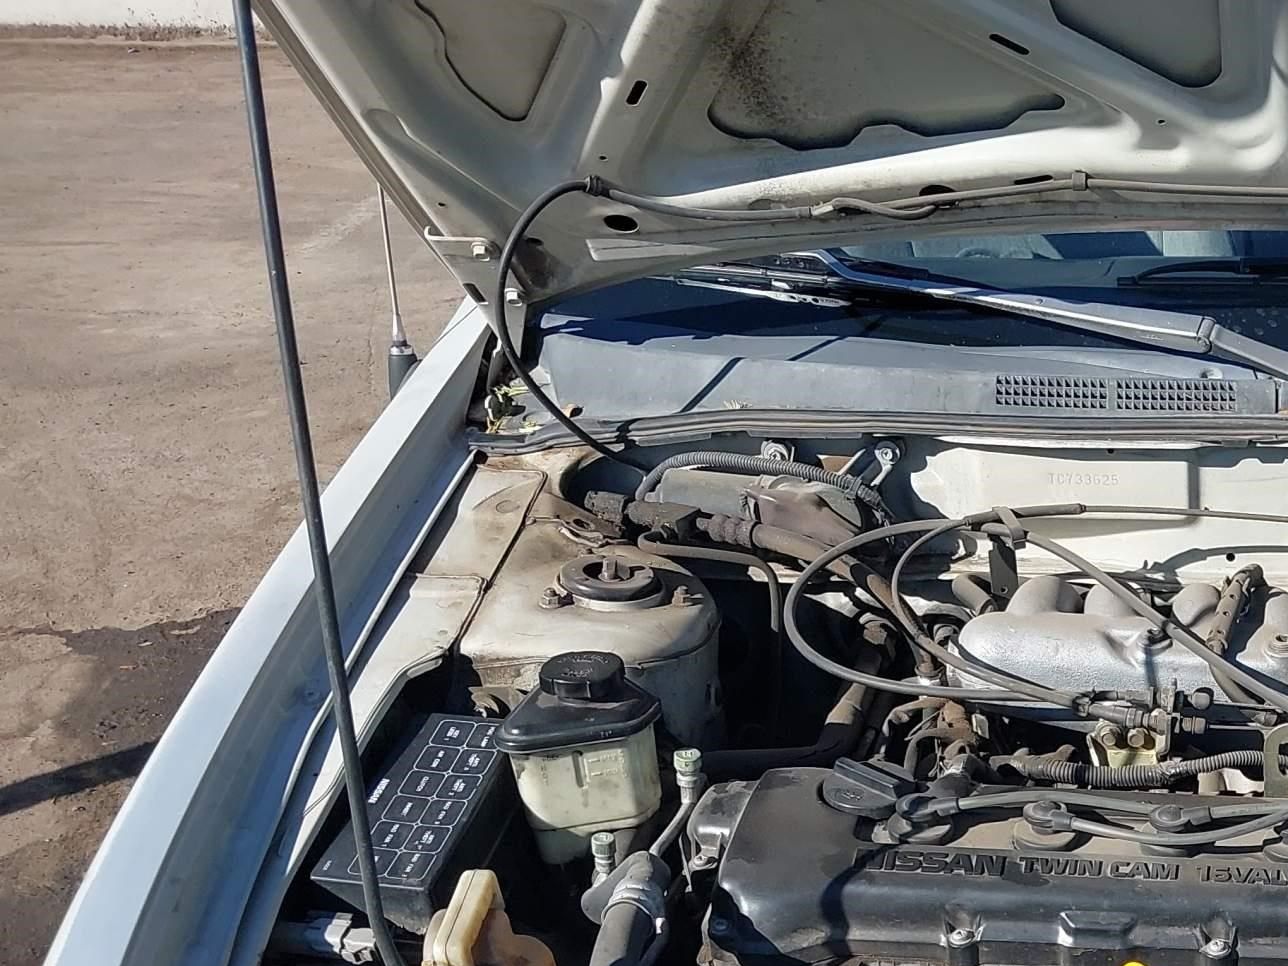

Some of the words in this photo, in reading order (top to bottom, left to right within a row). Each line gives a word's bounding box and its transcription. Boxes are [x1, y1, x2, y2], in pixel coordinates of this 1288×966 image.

[367, 777, 391, 804] NISSAN
[865, 849, 1007, 876] NISSAN
[1019, 856, 1103, 878] TWIN
[1109, 861, 1180, 881] CAM
